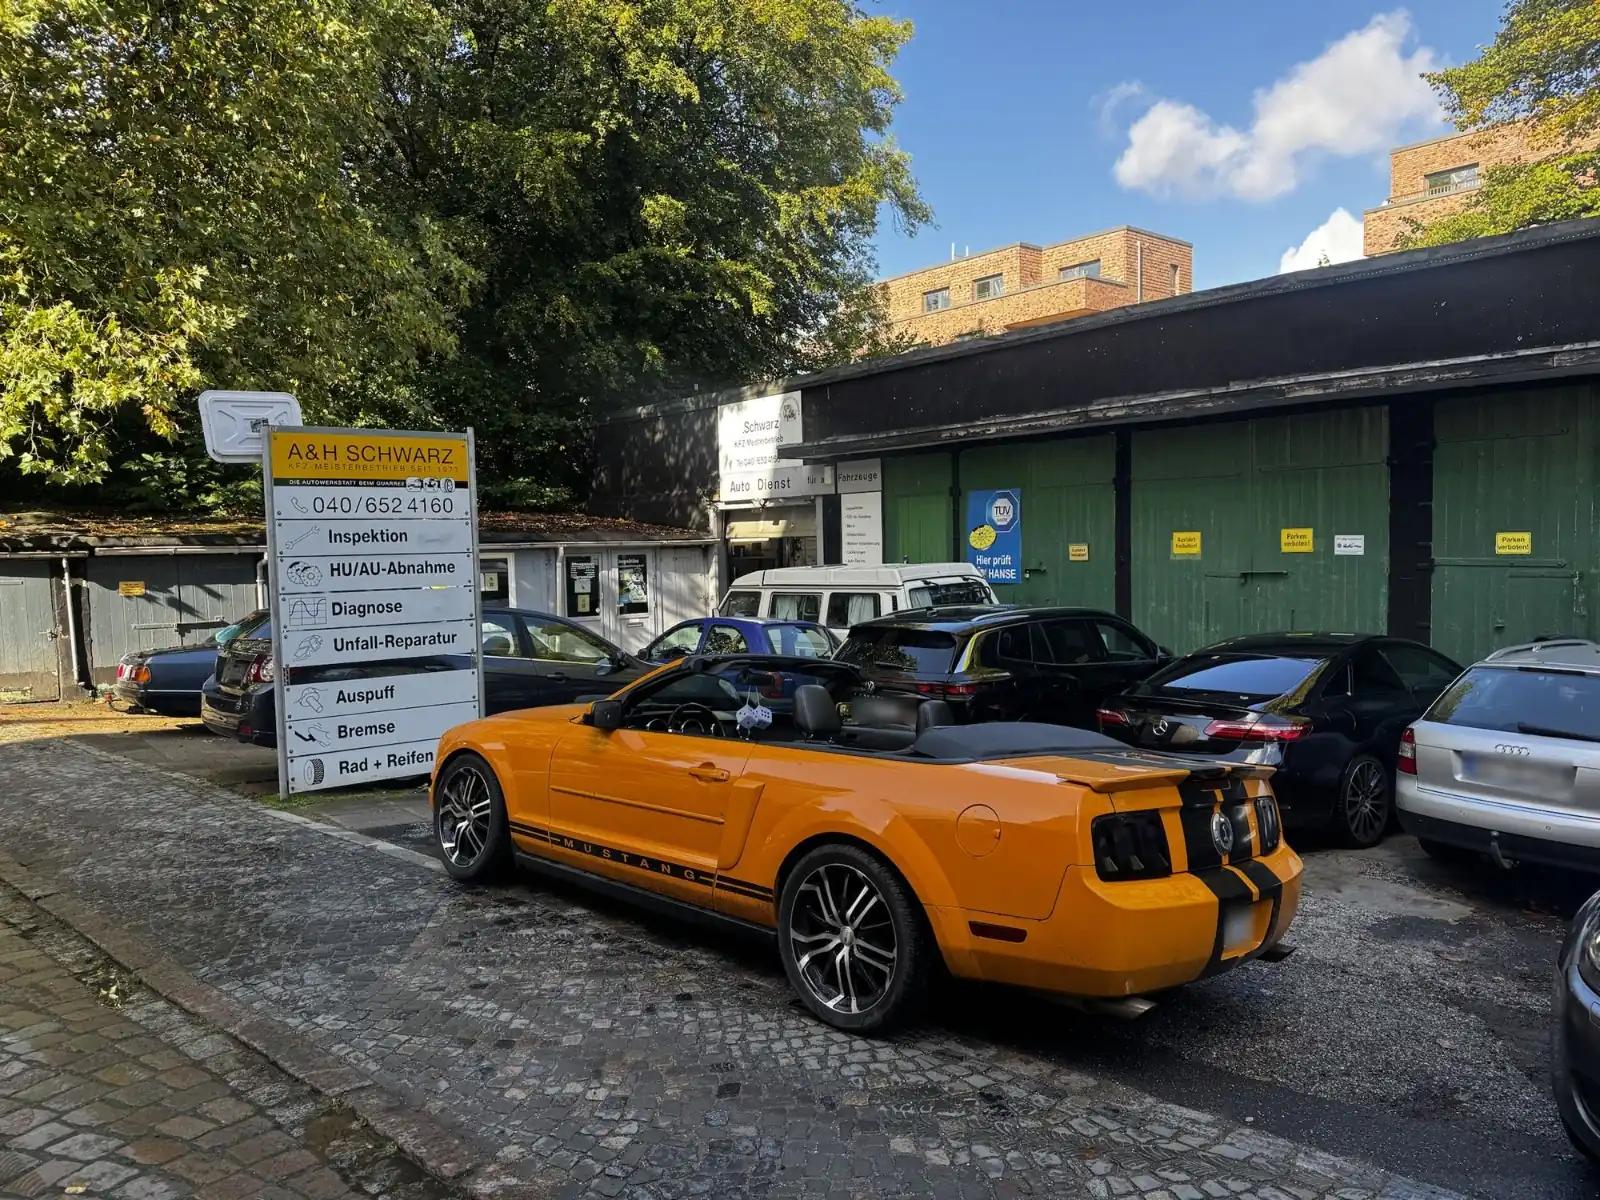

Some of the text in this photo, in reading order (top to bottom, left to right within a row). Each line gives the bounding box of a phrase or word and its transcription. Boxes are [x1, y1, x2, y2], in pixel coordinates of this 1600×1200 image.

[288, 443, 454, 464] A&H SCHWARZ
[288, 463, 406, 472] KFZ-MEISTERBETRIEB
[730, 481, 750, 493] Auto
[757, 477, 791, 491] Dienst
[807, 476, 816, 485] für
[838, 472, 878, 483] Fahrzeuge
[328, 528, 408, 546] Inspektion
[330, 561, 455, 577] HU/AU-Abnahme
[976, 554, 1011, 567] Hier prüft
[988, 569, 1016, 579] HANSE
[332, 601, 403, 618] Diagnose
[333, 632, 458, 651] Unfall-Reparatur
[336, 685, 396, 704] Auspuff
[337, 722, 396, 739] Bremse
[339, 751, 434, 775] Rad + Reifen
[564, 838, 696, 881] MUSTANG
